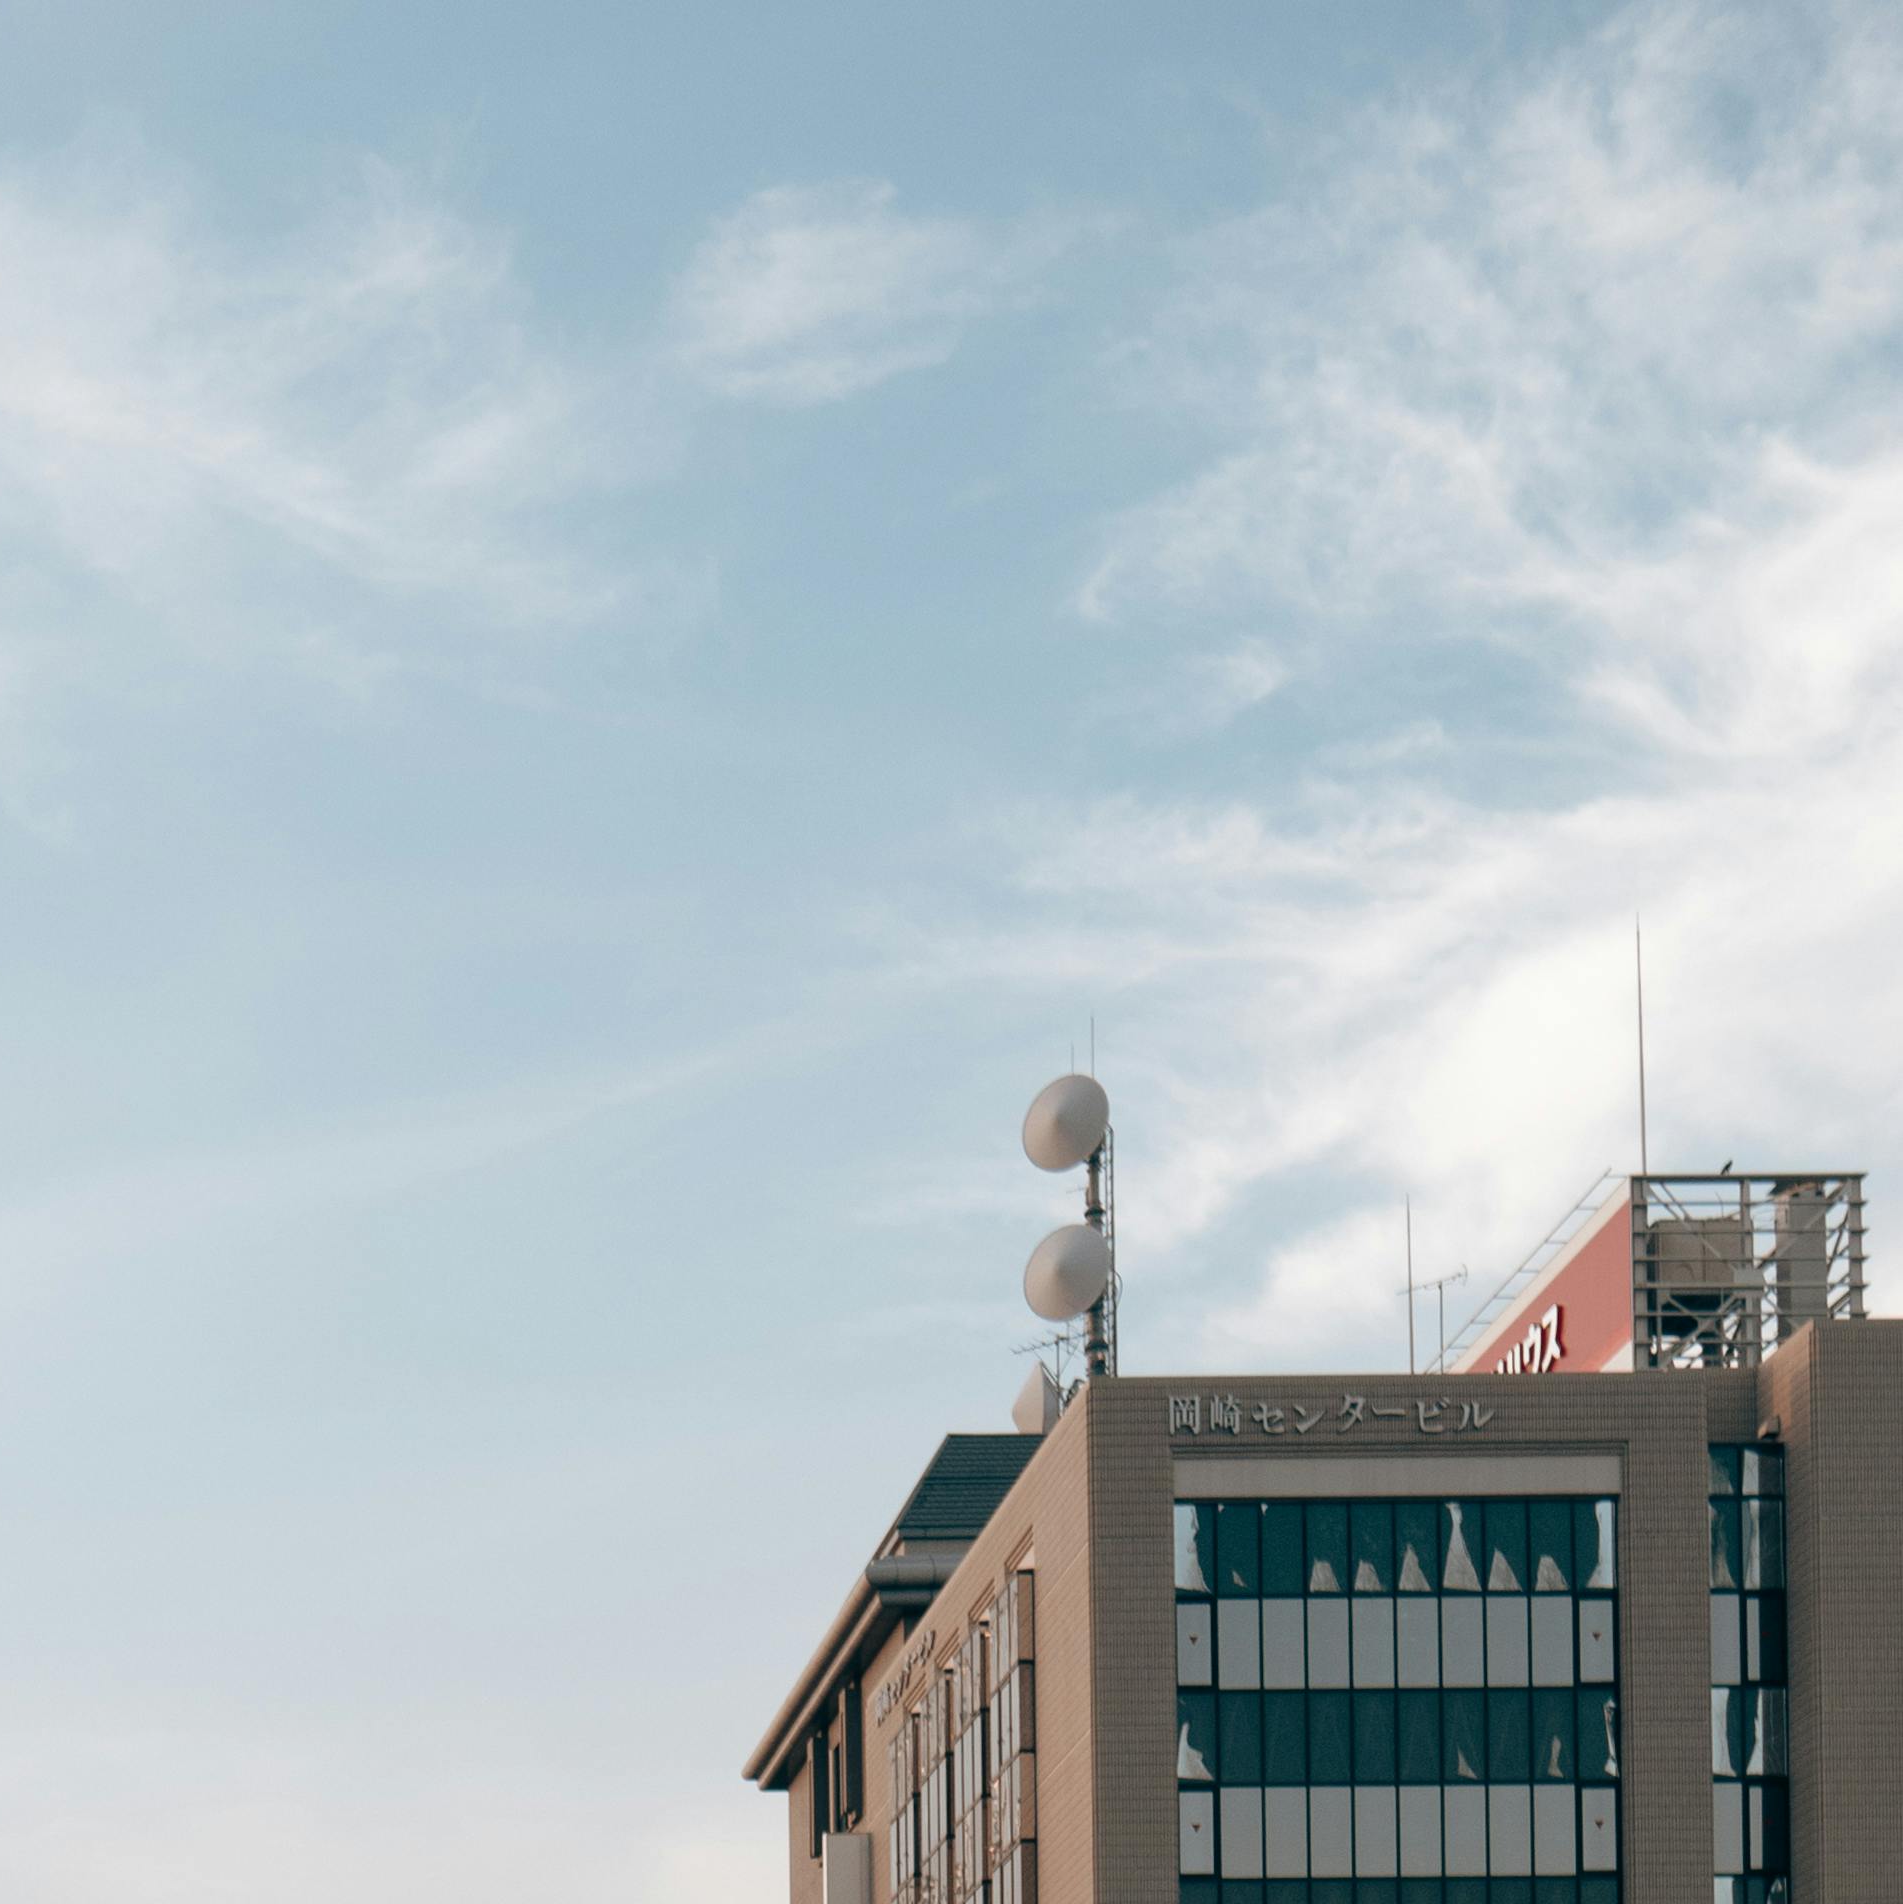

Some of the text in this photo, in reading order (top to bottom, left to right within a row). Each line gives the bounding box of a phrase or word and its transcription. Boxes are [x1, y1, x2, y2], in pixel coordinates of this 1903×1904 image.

[1169, 1394, 1495, 1436] 岡崎センタービル
